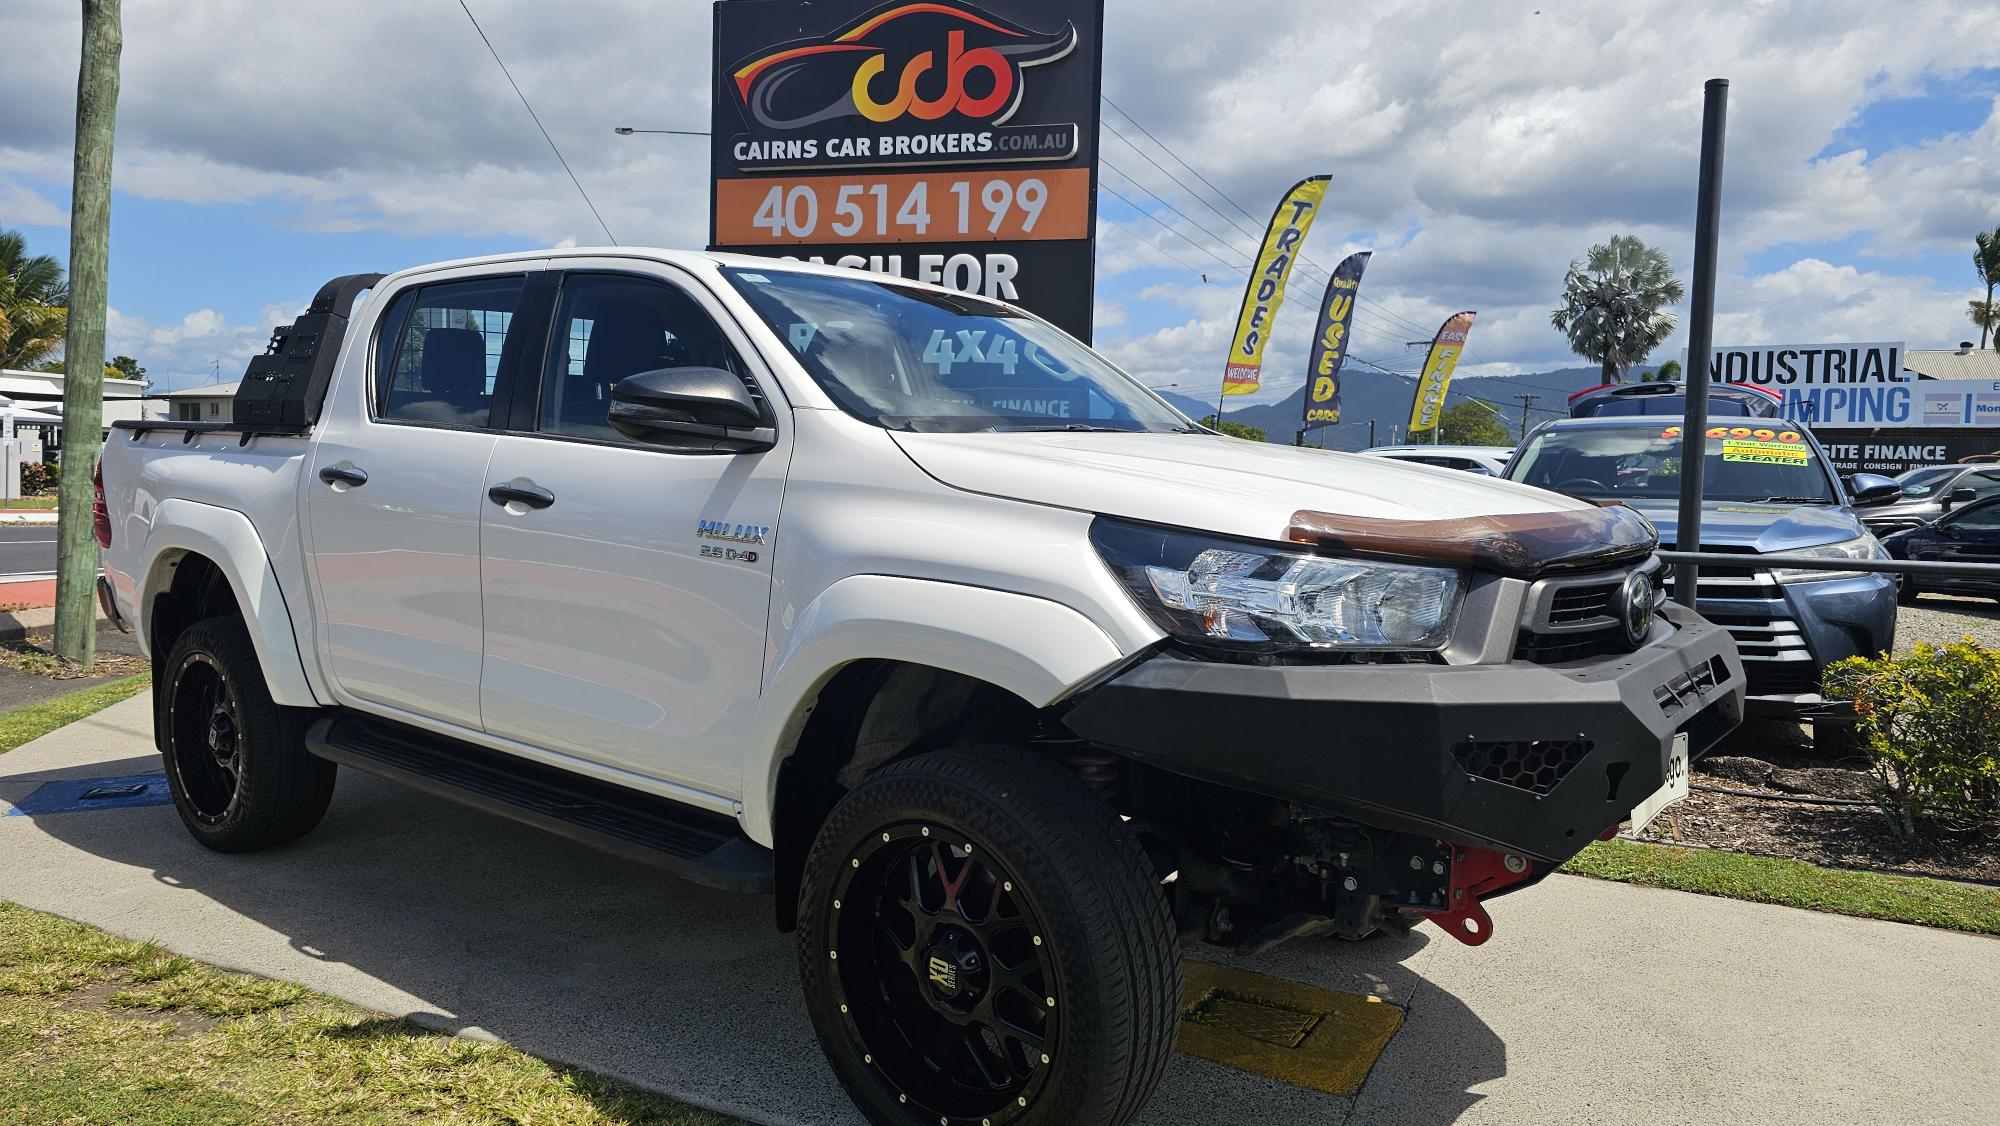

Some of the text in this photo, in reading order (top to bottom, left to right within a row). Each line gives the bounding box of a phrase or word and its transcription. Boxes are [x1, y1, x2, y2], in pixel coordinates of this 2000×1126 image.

[733, 138, 818, 161] CAIRNS
[825, 137, 871, 158] CAR
[752, 178, 1048, 238] 40 514 199
[918, 253, 1020, 300] FOR
[1242, 200, 1313, 356] TRADES
[1312, 294, 1352, 403] USED
[1441, 331, 1468, 343] EASY
[922, 329, 1019, 375] 4X4
[1227, 367, 1258, 380] WELCOME
[1710, 347, 1904, 385] NDUSTRIAL
[1420, 348, 1456, 426] FINANCE
[1306, 409, 1340, 423] CARS
[1777, 386, 1911, 423] MPING
[1660, 426, 1801, 444] $6990
[1759, 441, 1804, 451] Warranty
[1732, 447, 1800, 457] Automatic
[1740, 454, 1806, 465] SEATER
[1864, 445, 1947, 461] FINANCE
[1832, 462, 1940, 471] TRADE CONSIGN FINA
[696, 520, 769, 545] HILUX
[930, 957, 949, 987] XD
[948, 963, 957, 989] SERIES
